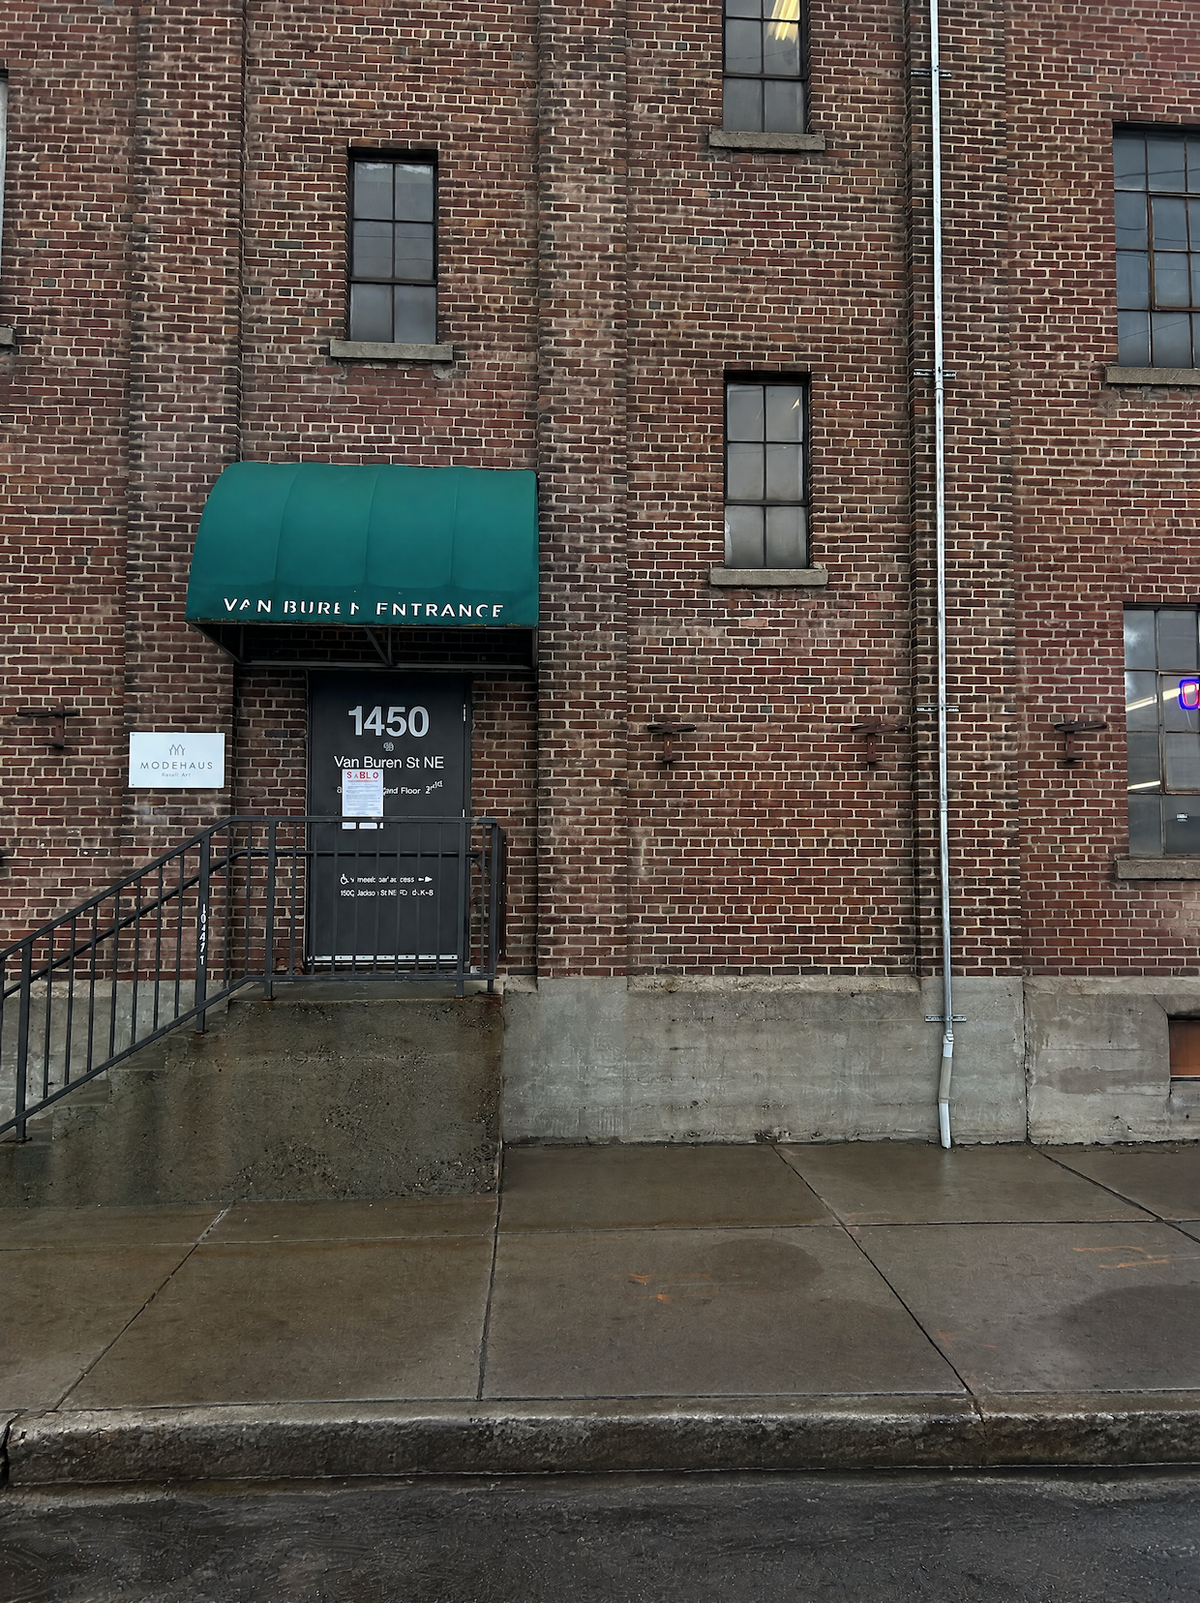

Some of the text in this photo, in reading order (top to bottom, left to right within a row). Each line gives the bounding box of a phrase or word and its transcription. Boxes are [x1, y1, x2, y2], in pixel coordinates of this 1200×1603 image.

[223, 597, 272, 613] VAN
[348, 705, 430, 738] 1450
[140, 761, 213, 770] MODEHAUS
[334, 755, 444, 769] Van Buren St NE
[401, 786, 421, 795] Floor
